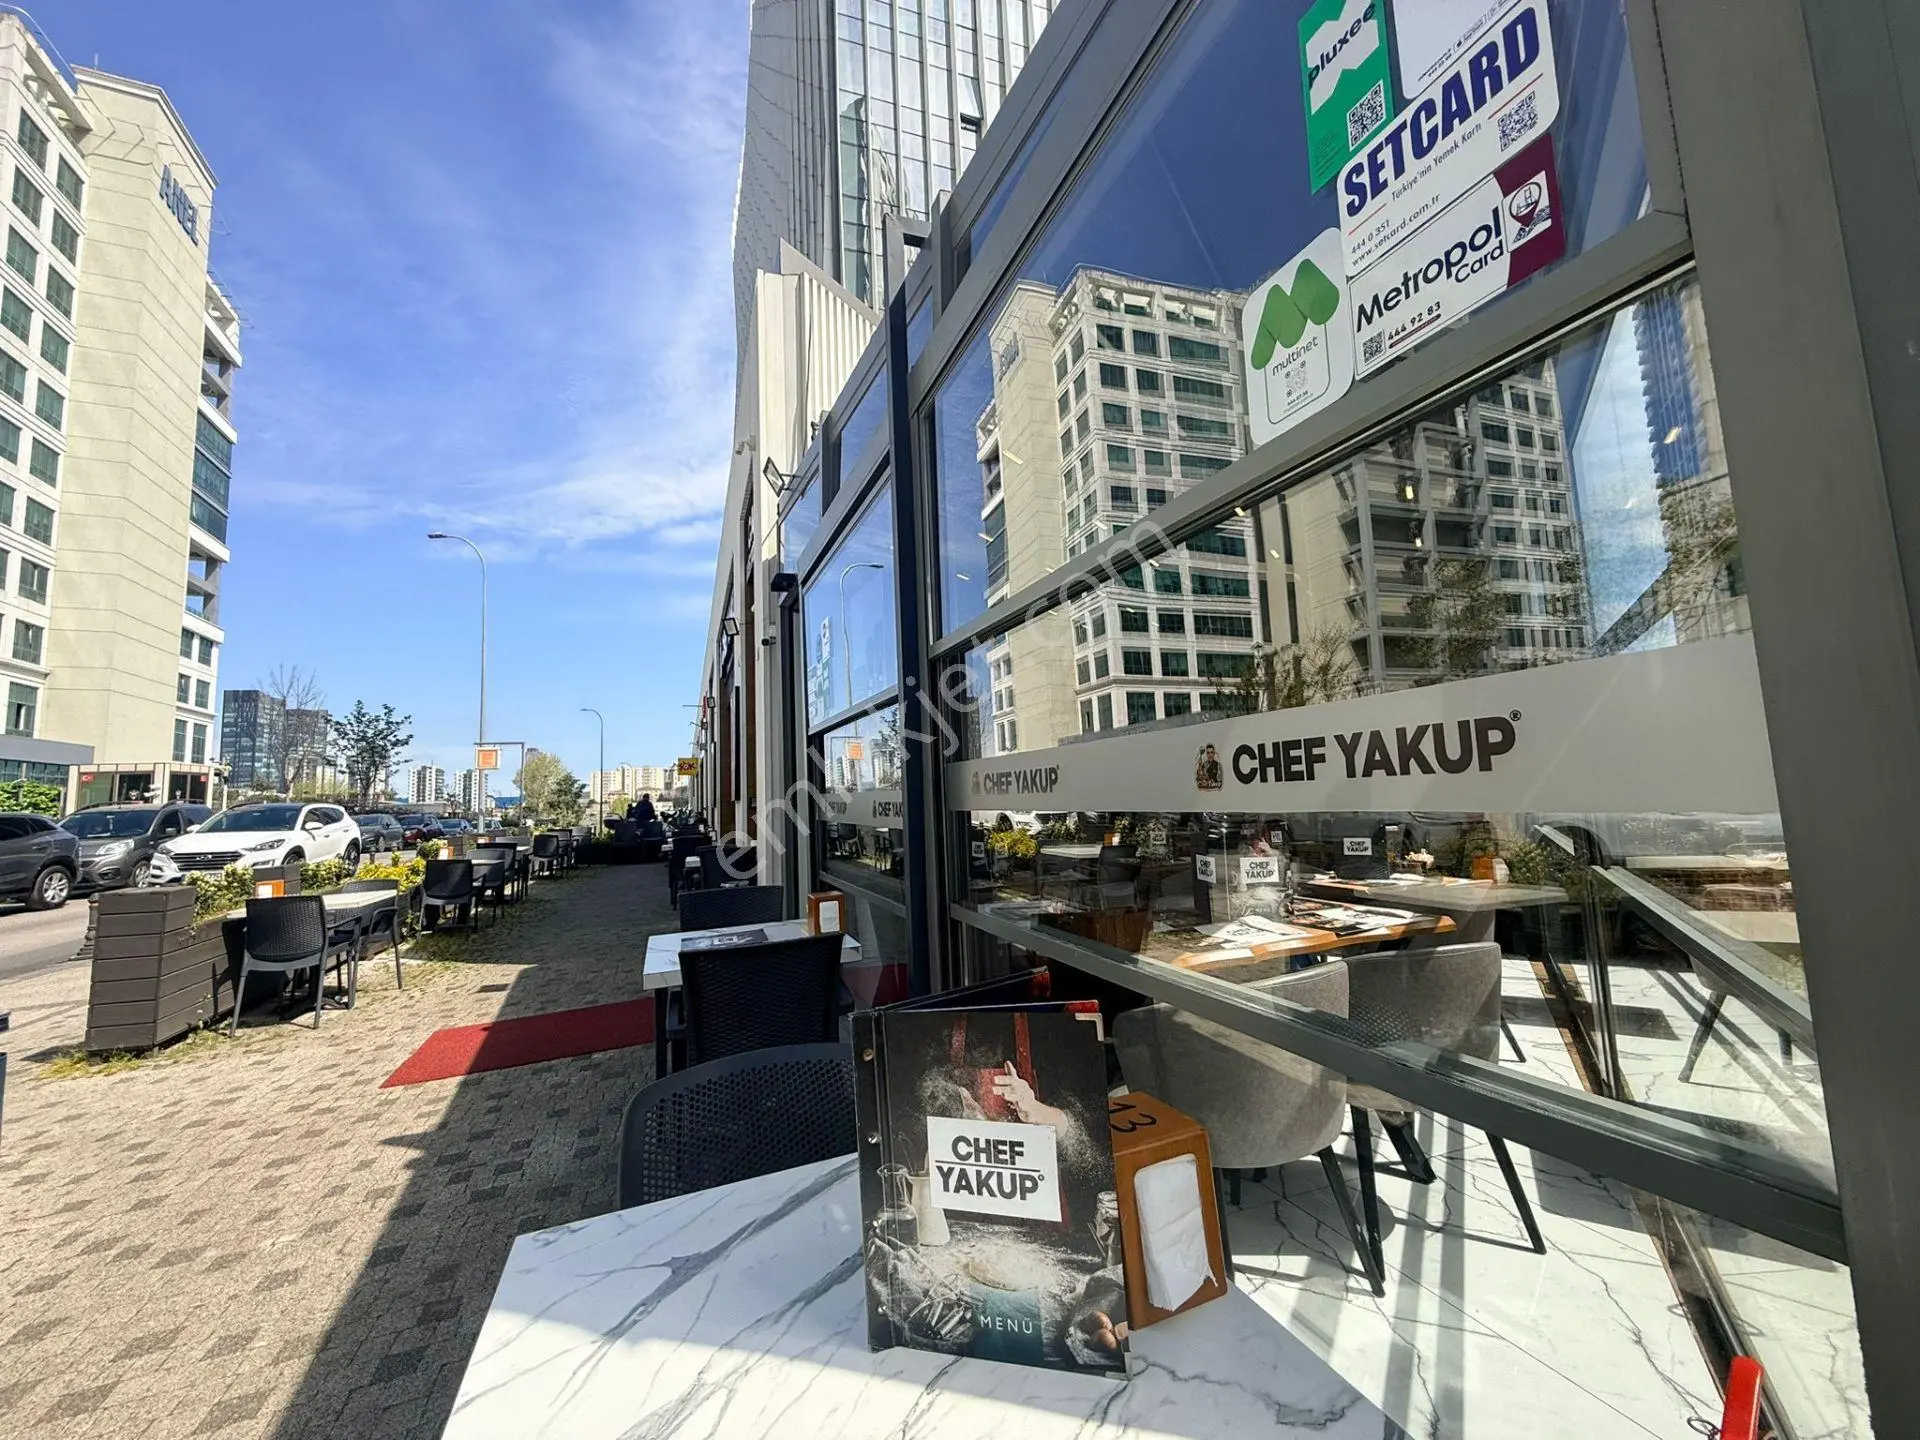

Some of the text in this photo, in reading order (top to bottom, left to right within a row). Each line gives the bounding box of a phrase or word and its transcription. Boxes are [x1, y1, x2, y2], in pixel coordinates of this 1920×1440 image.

[1308, 3, 1376, 90] pluxee
[1343, 6, 1540, 217] SETCARD
[1433, 140, 1460, 167] Yemek
[1351, 238, 1366, 254] 444
[1375, 219, 1390, 237] 351
[1352, 194, 1440, 267] www.setcard.com.tr
[1357, 205, 1502, 333] Metropol
[1455, 239, 1504, 283] Card
[1387, 300, 1441, 341] 444 92 83
[1272, 336, 1319, 376] multinet
[983, 766, 1059, 795] CHEF YAKUP
[1232, 737, 1326, 785] CHEF
[1245, 870, 1274, 878] YAKUP
[1249, 861, 1270, 869] CHEF
[951, 1135, 1024, 1166] CHEF
[980, 1315, 1033, 1334] MENÜ
